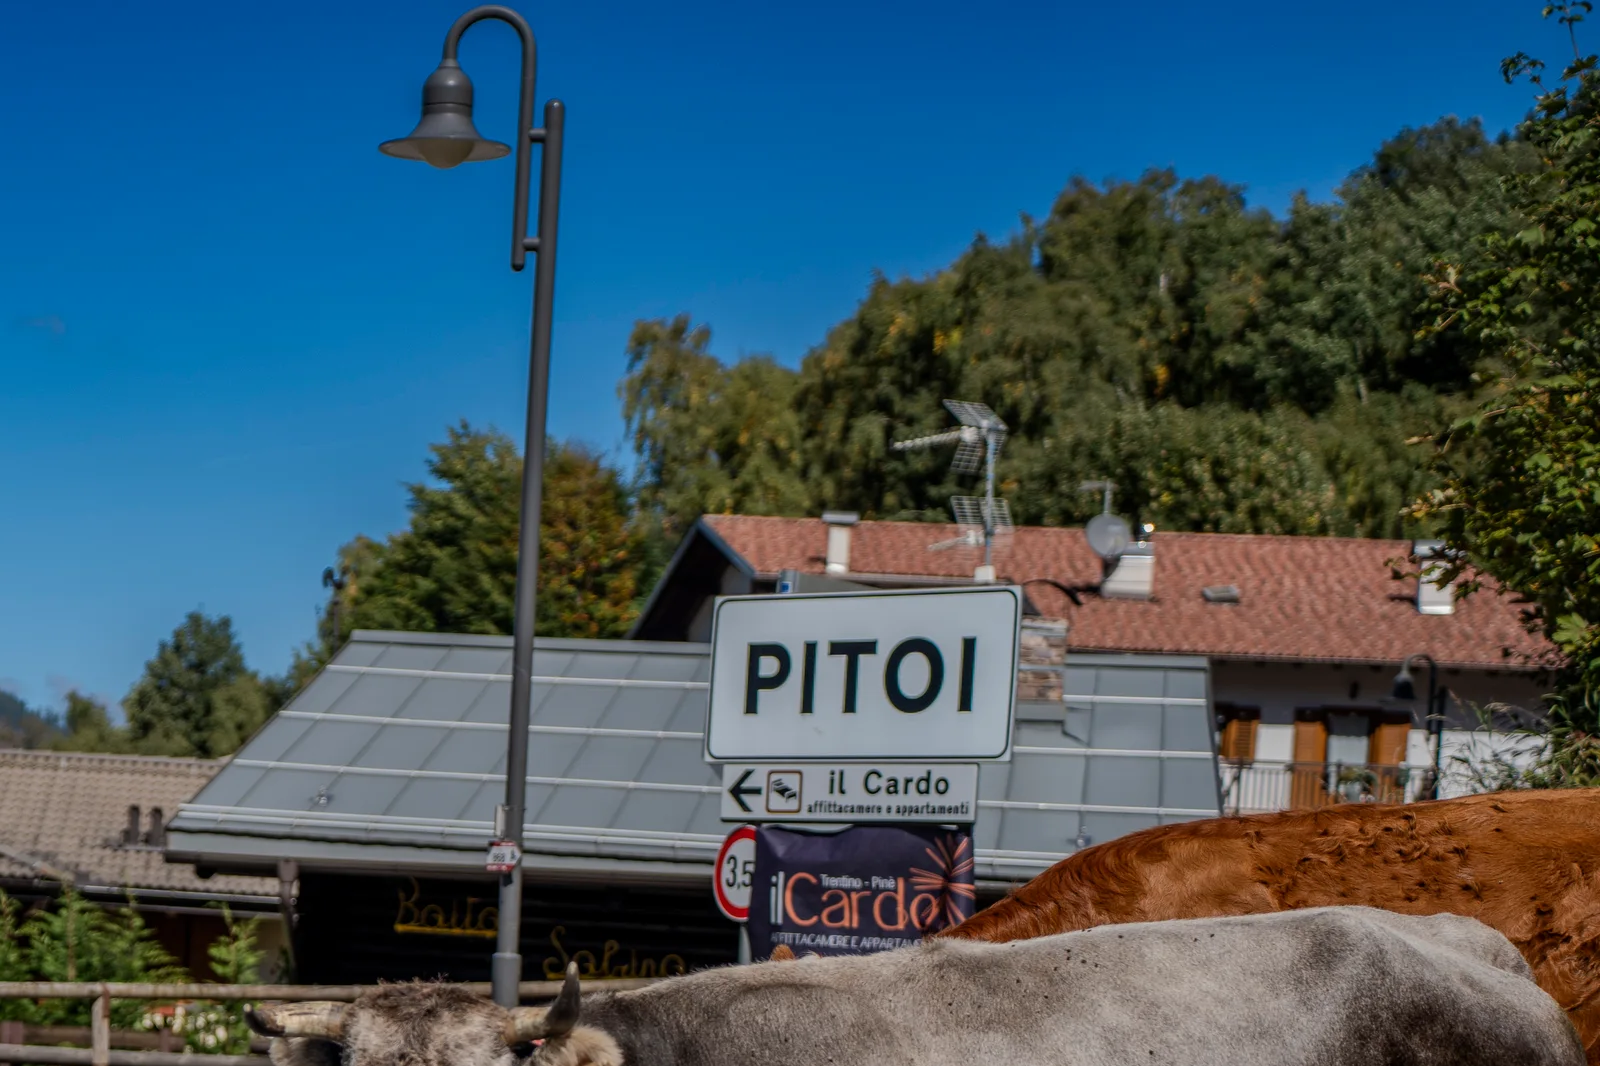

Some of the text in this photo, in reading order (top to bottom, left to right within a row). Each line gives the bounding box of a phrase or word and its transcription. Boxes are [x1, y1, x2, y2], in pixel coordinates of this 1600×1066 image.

[744, 636, 977, 715] PITOI
[828, 768, 950, 795] il Cardo
[807, 801, 969, 816] affittacamere e appartamenti
[819, 873, 862, 888] Trentino
[871, 875, 896, 890] Pinè
[851, 936, 858, 948] E
